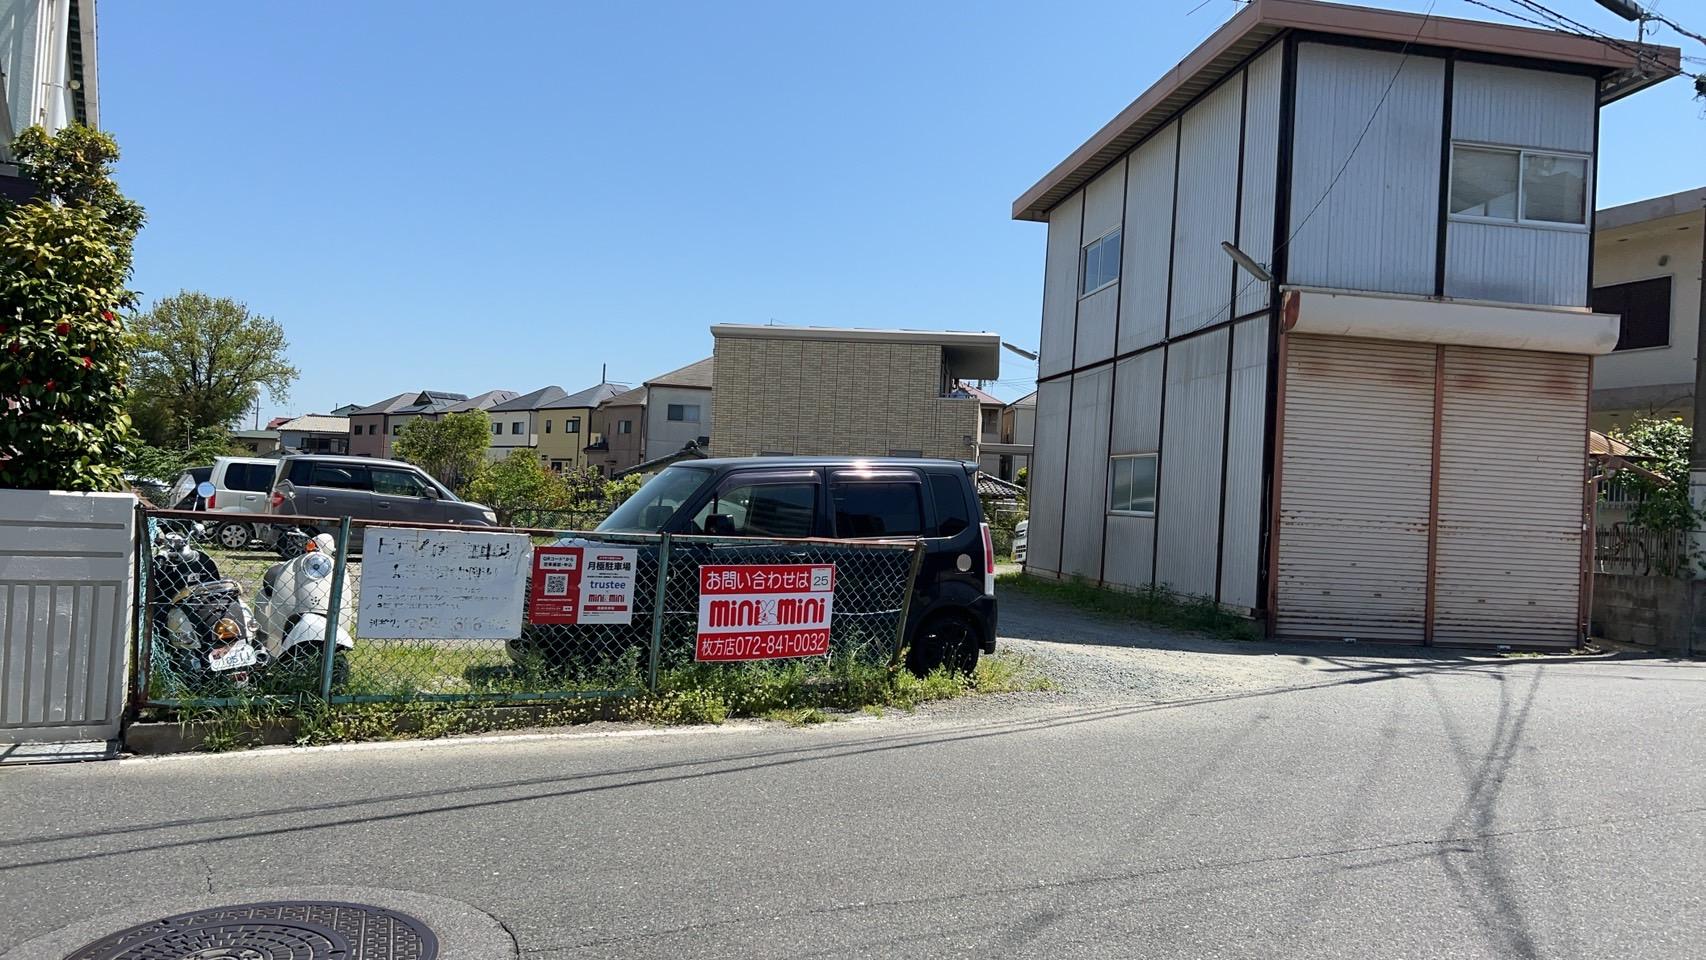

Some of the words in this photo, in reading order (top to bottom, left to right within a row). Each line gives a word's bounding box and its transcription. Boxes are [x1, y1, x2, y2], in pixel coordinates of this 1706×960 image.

[587, 561, 631, 571] 月極駐車場
[590, 580, 626, 589] trustee
[706, 571, 809, 590] お問い合わせは
[813, 575, 829, 586] 25
[709, 600, 761, 627] mini
[777, 598, 825, 625] mini
